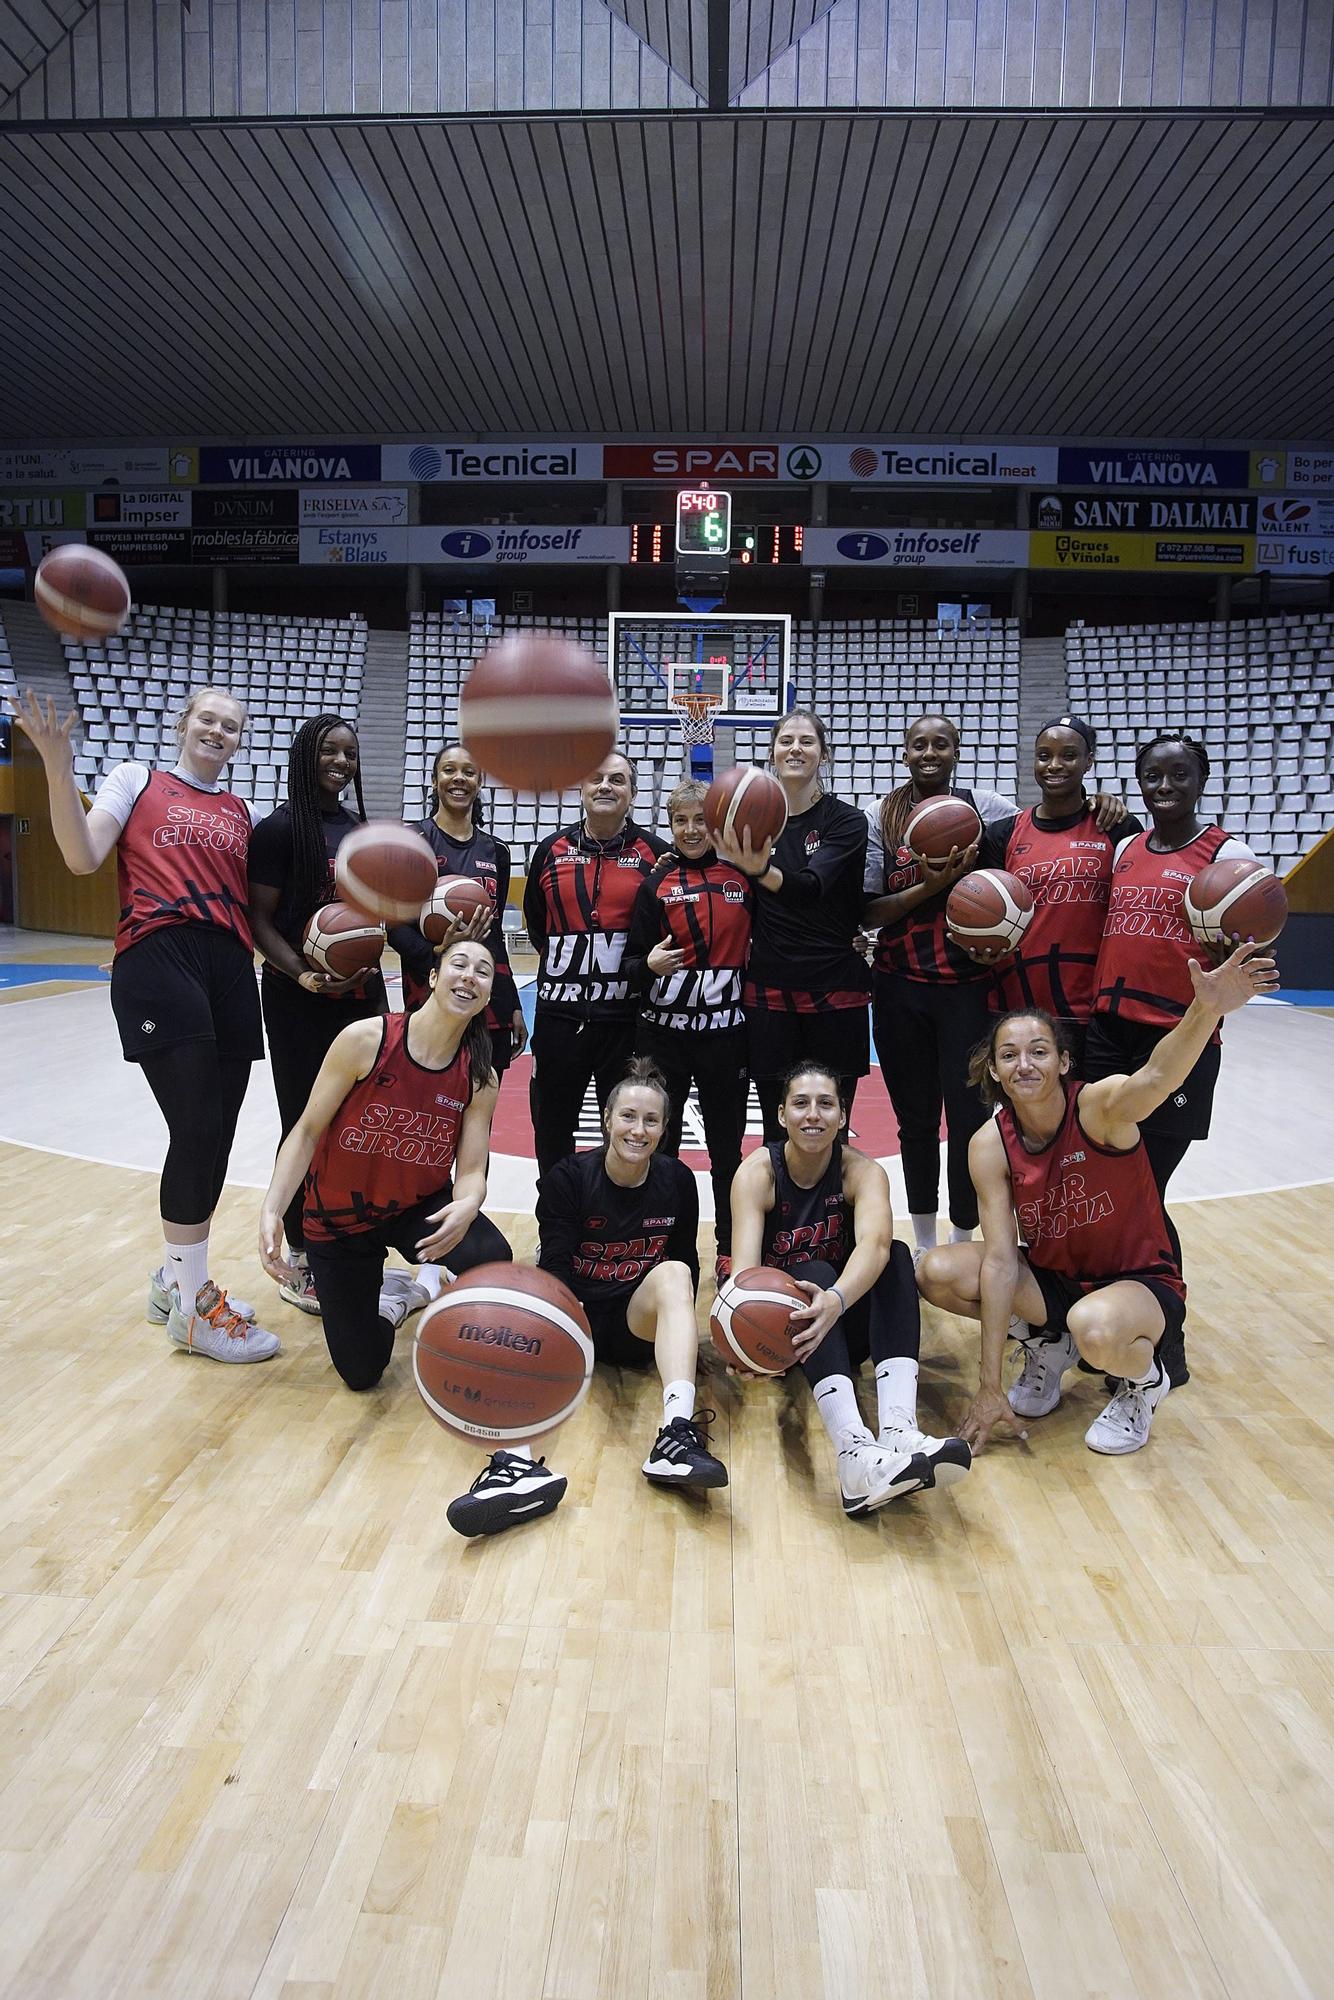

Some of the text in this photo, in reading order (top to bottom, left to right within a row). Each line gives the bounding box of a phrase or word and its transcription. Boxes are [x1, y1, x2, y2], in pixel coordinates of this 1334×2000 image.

[264, 449, 316, 457] CATERING
[1127, 452, 1181, 461] CATERING
[228, 457, 352, 480] VILANOVA
[445, 448, 577, 476] Tecnical
[653, 450, 776, 473] SPAR
[882, 450, 1037, 477] Tecnical meat
[1294, 457, 1334, 470] Bo per
[15, 469, 25, 479] la
[1088, 461, 1218, 485] VILANOVA
[1293, 471, 1334, 483] Bo per
[123, 493, 185, 503] La DIGITAL
[303, 499, 391, 512] FRISELVA S.A.
[123, 508, 180, 526] impser
[1074, 500, 1250, 529] SANT DALMAI
[704, 512, 723, 542] 6
[1261, 522, 1310, 533] VALENT
[94, 533, 185, 542] SERVEIS INTEGRALS
[318, 528, 378, 548] Estanys
[496, 529, 582, 550] infoself
[895, 532, 981, 554] infoself
[345, 547, 388, 563] Blaus
[495, 551, 527, 562] group
[742, 552, 750, 563] 0
[893, 554, 926, 566] group
[1071, 552, 1120, 564] Viñolas
[1014, 857, 1101, 887] SPAR
[1163, 870, 1191, 880] SPAR
[1109, 886, 1184, 913] SPAR
[1103, 911, 1192, 944] IRONA
[437, 1096, 461, 1109] SPAR
[360, 1103, 456, 1143] SPAR
[643, 1219, 668, 1227] SPAR
[581, 1235, 669, 1262] SPAR
[458, 1323, 542, 1356] molten
[443, 1380, 462, 1395] LF
